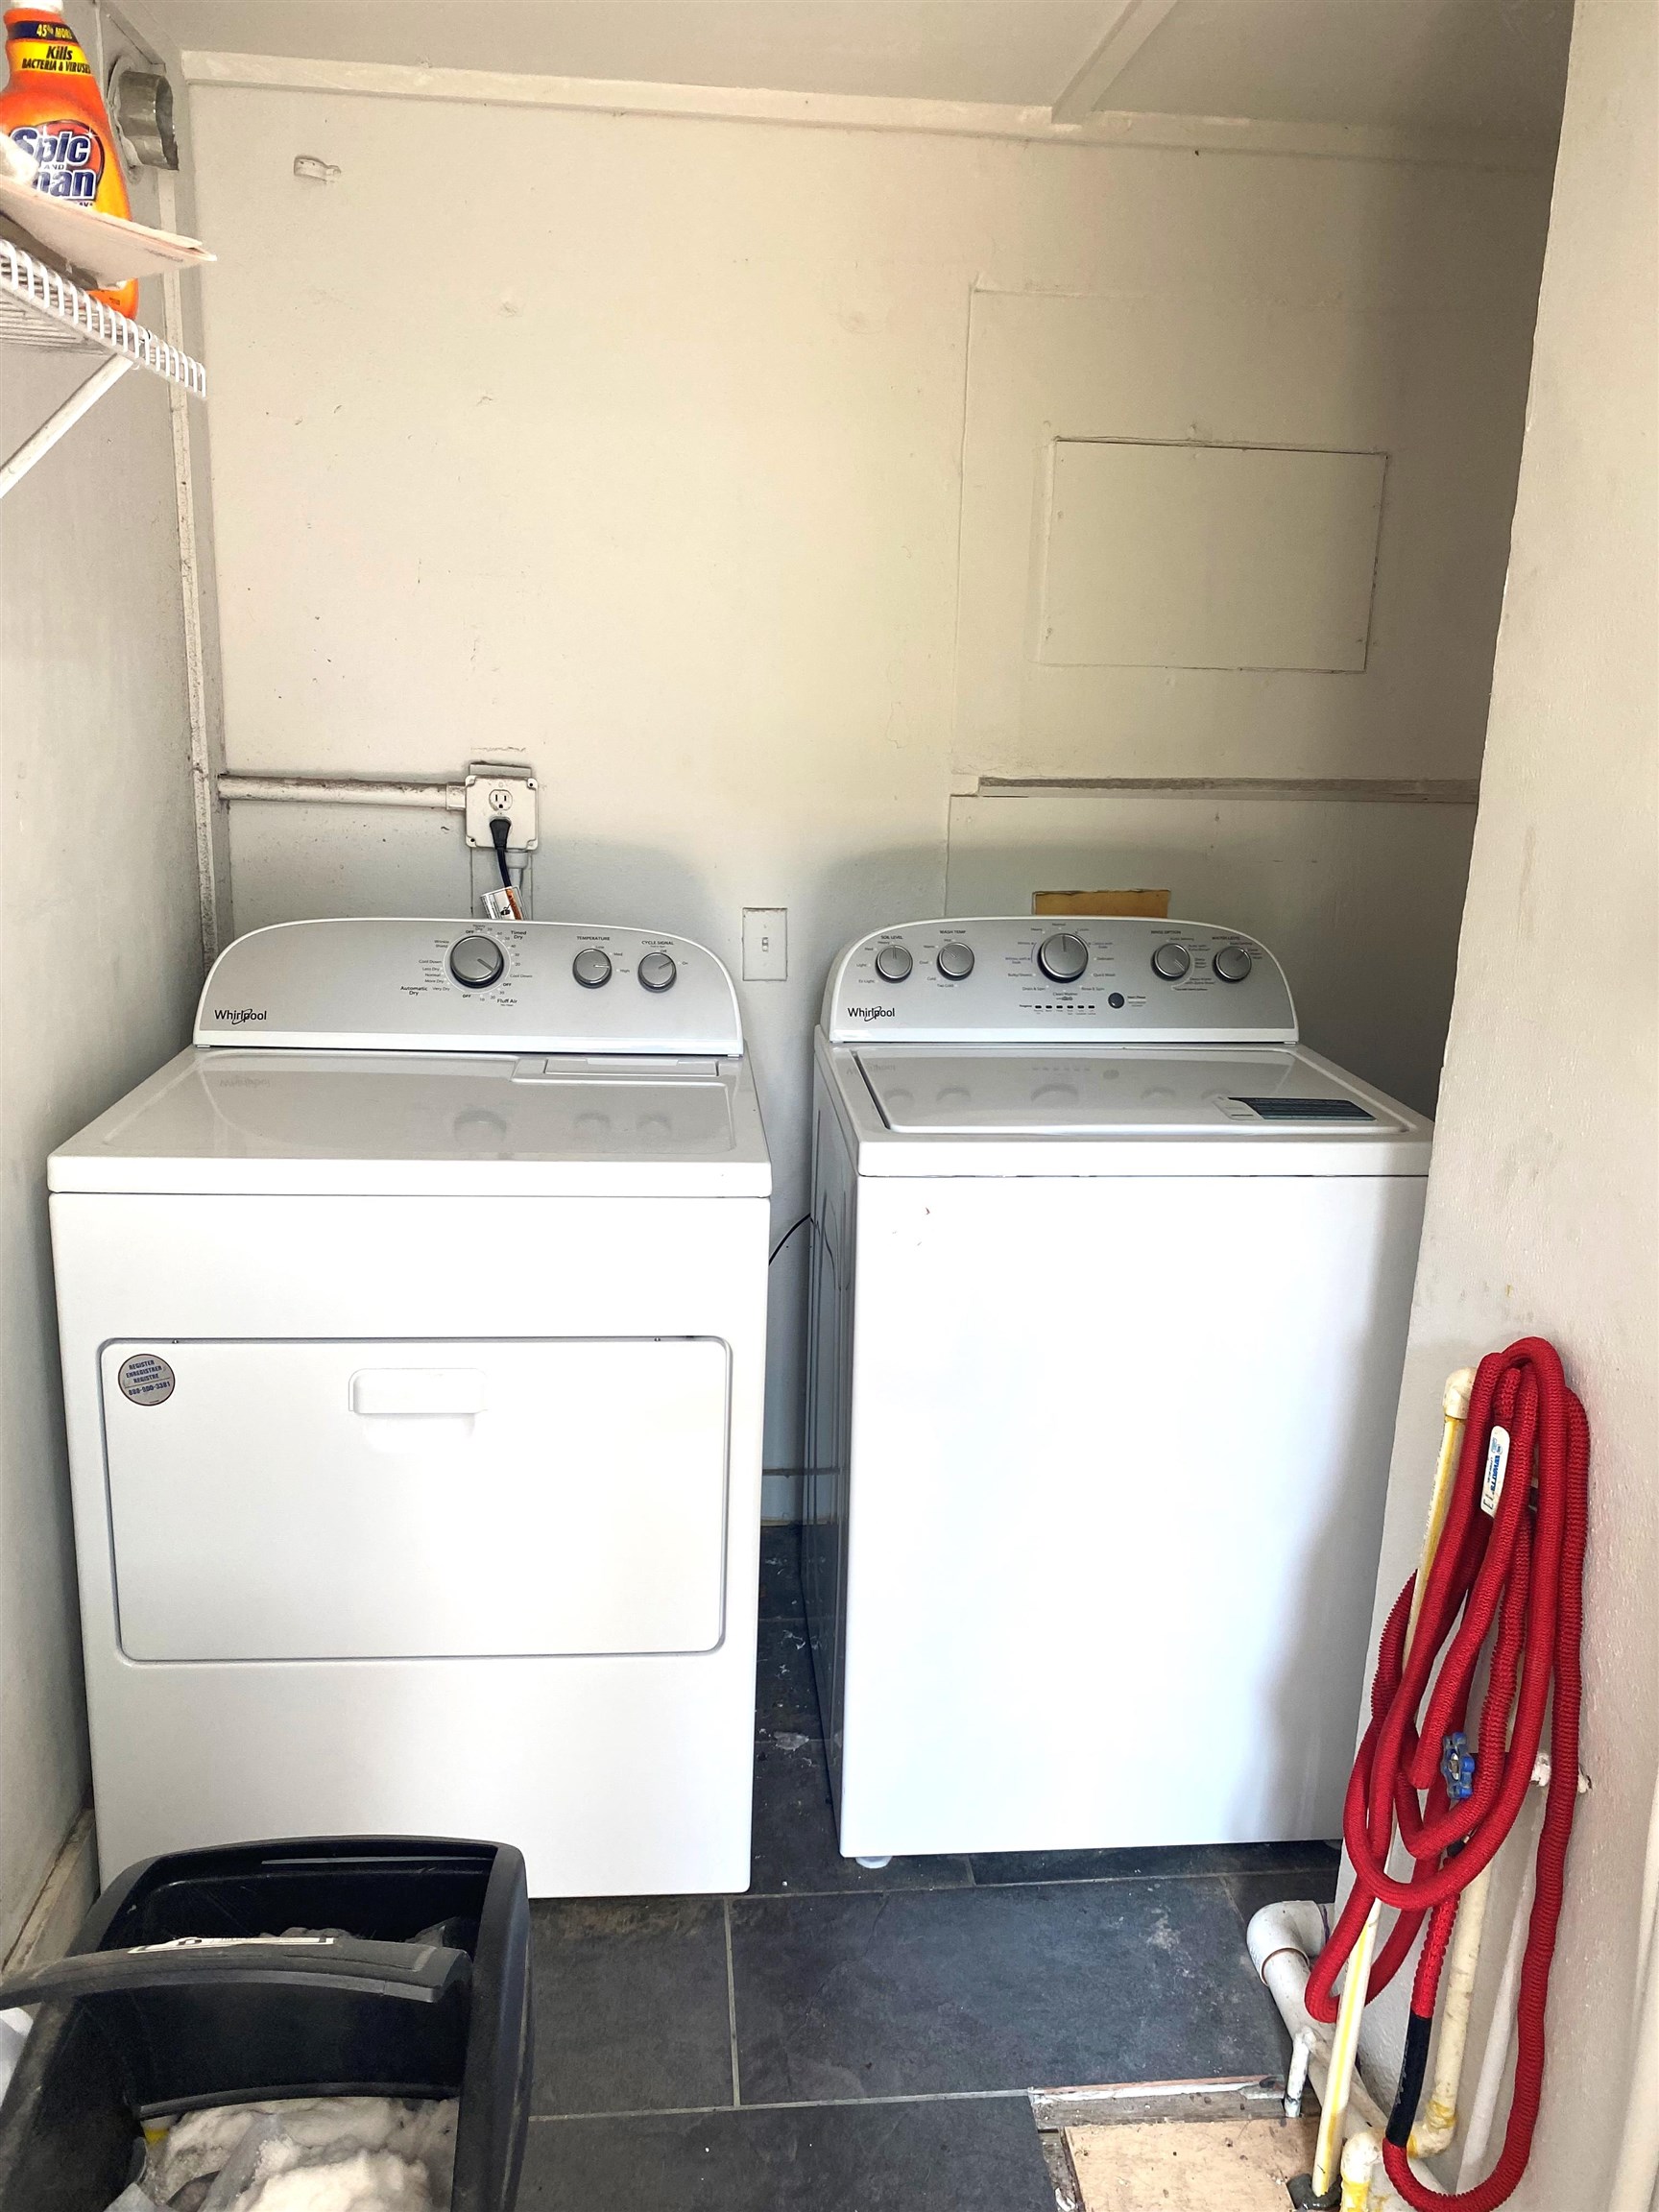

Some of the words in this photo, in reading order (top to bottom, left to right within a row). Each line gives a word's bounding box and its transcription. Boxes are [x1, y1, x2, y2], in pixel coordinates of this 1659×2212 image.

[36, 24, 53, 37] 45%
[46, 46, 73, 60] Kills
[22, 59, 57, 71] BACTERIA
[58, 60, 63, 71] &
[65, 61, 91, 74] VIRUSES
[214, 1008, 267, 1024] Whirlpool
[848, 1006, 895, 1022] Whirlpool
[126, 1365, 162, 1378] ENREGISTRER
[129, 1359, 155, 1370] REGISTER
